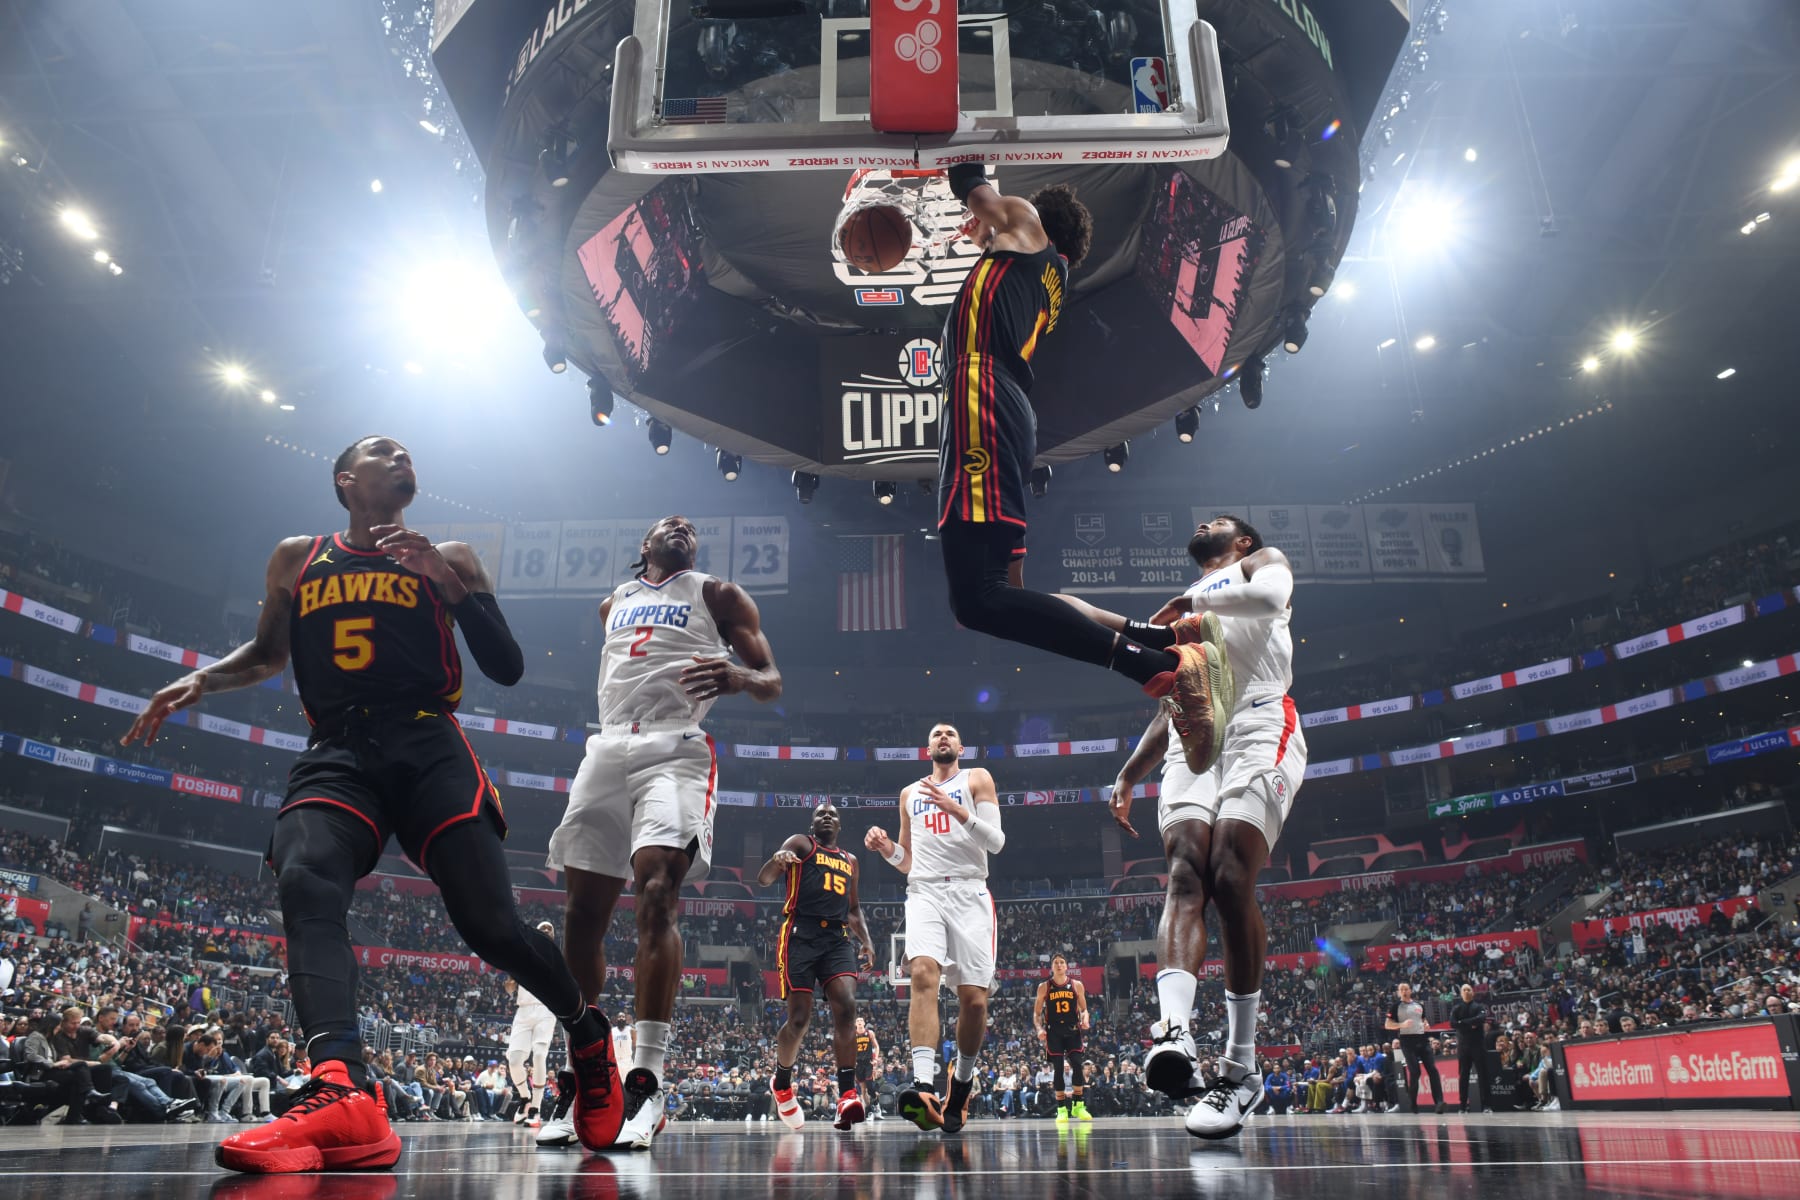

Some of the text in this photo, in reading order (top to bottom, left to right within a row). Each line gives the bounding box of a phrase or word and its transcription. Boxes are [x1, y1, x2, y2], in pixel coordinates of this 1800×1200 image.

[935, 153, 985, 166] HERDEZ
[989, 153, 1001, 162] IS
[1081, 150, 1133, 160] HERDEZ
[1136, 150, 1148, 159] IS
[642, 161, 693, 170] HERDEZ
[696, 161, 708, 169] IS
[788, 158, 839, 166] HERDEZ
[842, 157, 854, 165] IS
[1041, 262, 1062, 336] JOHNSON
[842, 391, 943, 451] CLIPP
[742, 526, 781, 536] BROWN
[1062, 547, 1121, 558] STANLEY CUP
[1129, 547, 1189, 557] STANLEY CUP
[512, 547, 545, 578] 18
[565, 546, 609, 577] 99
[741, 543, 780, 575] 23
[1062, 557, 1123, 568] CHAMPIONS
[1129, 556, 1191, 568] CHAMPIONS
[1071, 571, 1116, 583] 2013-14
[1140, 571, 1183, 583] 2011-12
[300, 571, 420, 618] HAWKS
[34, 609, 45, 620] 95
[611, 604, 692, 632] CLIPPERS
[1696, 617, 1728, 633] 95 CALS
[333, 616, 375, 672] 5
[629, 626, 654, 657] 2
[1528, 668, 1557, 680] 95 CALS
[1750, 736, 1785, 750] ULTRA
[28, 745, 91, 769] UCLA Health
[118, 766, 165, 783] crypto.com
[176, 776, 239, 801] TOSHIBA
[1513, 785, 1558, 801] DELTA
[841, 797, 849, 807] 5
[865, 798, 896, 808] Clippers
[1007, 795, 1016, 805] 6
[1457, 796, 1487, 814] Sprite
[924, 811, 951, 835] 40
[823, 871, 847, 896] 15
[695, 900, 736, 916] CLIPPERS
[380, 952, 470, 971] CLIPPERS.COM
[1049, 990, 1074, 1001] HAWKS
[1055, 1001, 1070, 1013] 13
[857, 1043, 868, 1052] 27
